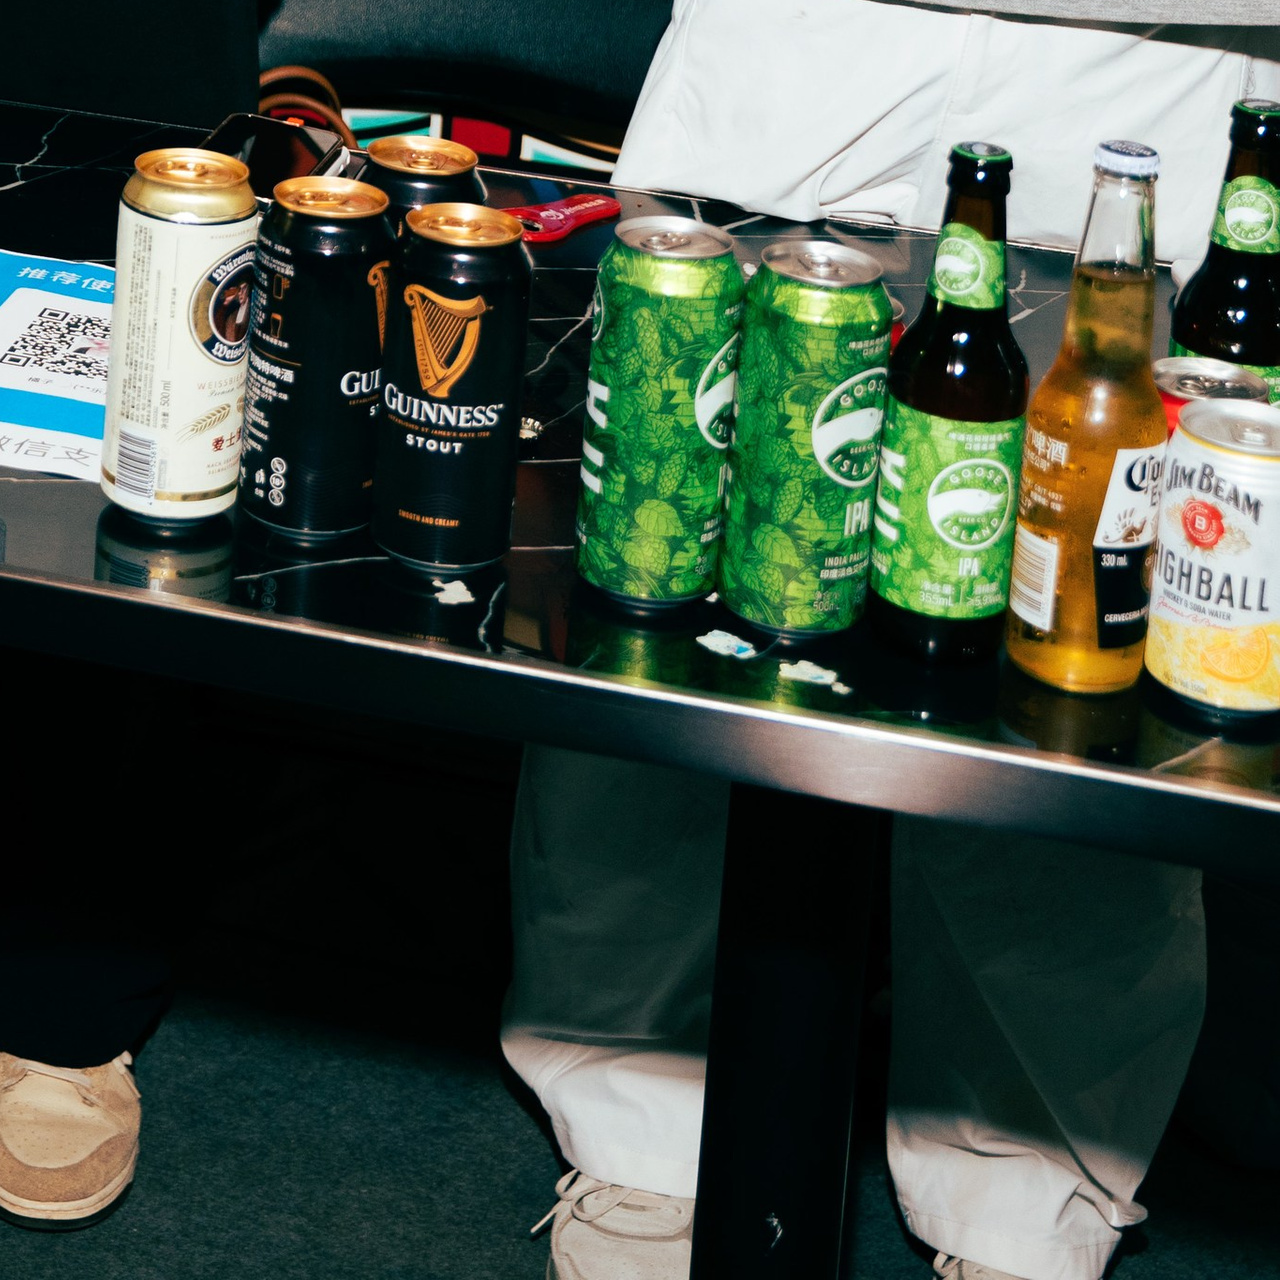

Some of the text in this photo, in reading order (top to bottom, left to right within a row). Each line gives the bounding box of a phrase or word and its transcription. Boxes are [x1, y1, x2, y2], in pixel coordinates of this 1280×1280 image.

[384, 382, 499, 427] GUINNESS
[406, 433, 463, 454] STOUT
[1026, 428, 1068, 466] 啤酒
[949, 466, 1002, 486] GOOSE
[1166, 458, 1263, 526] JIM BEAM
[421, 515, 434, 525] AND
[844, 497, 870, 537] IPA
[943, 517, 999, 542] ISLAND
[824, 555, 848, 567] INDIA
[958, 556, 981, 577] IPA
[1101, 553, 1115, 567] 330
[1153, 540, 1270, 613] HIGHBALL
